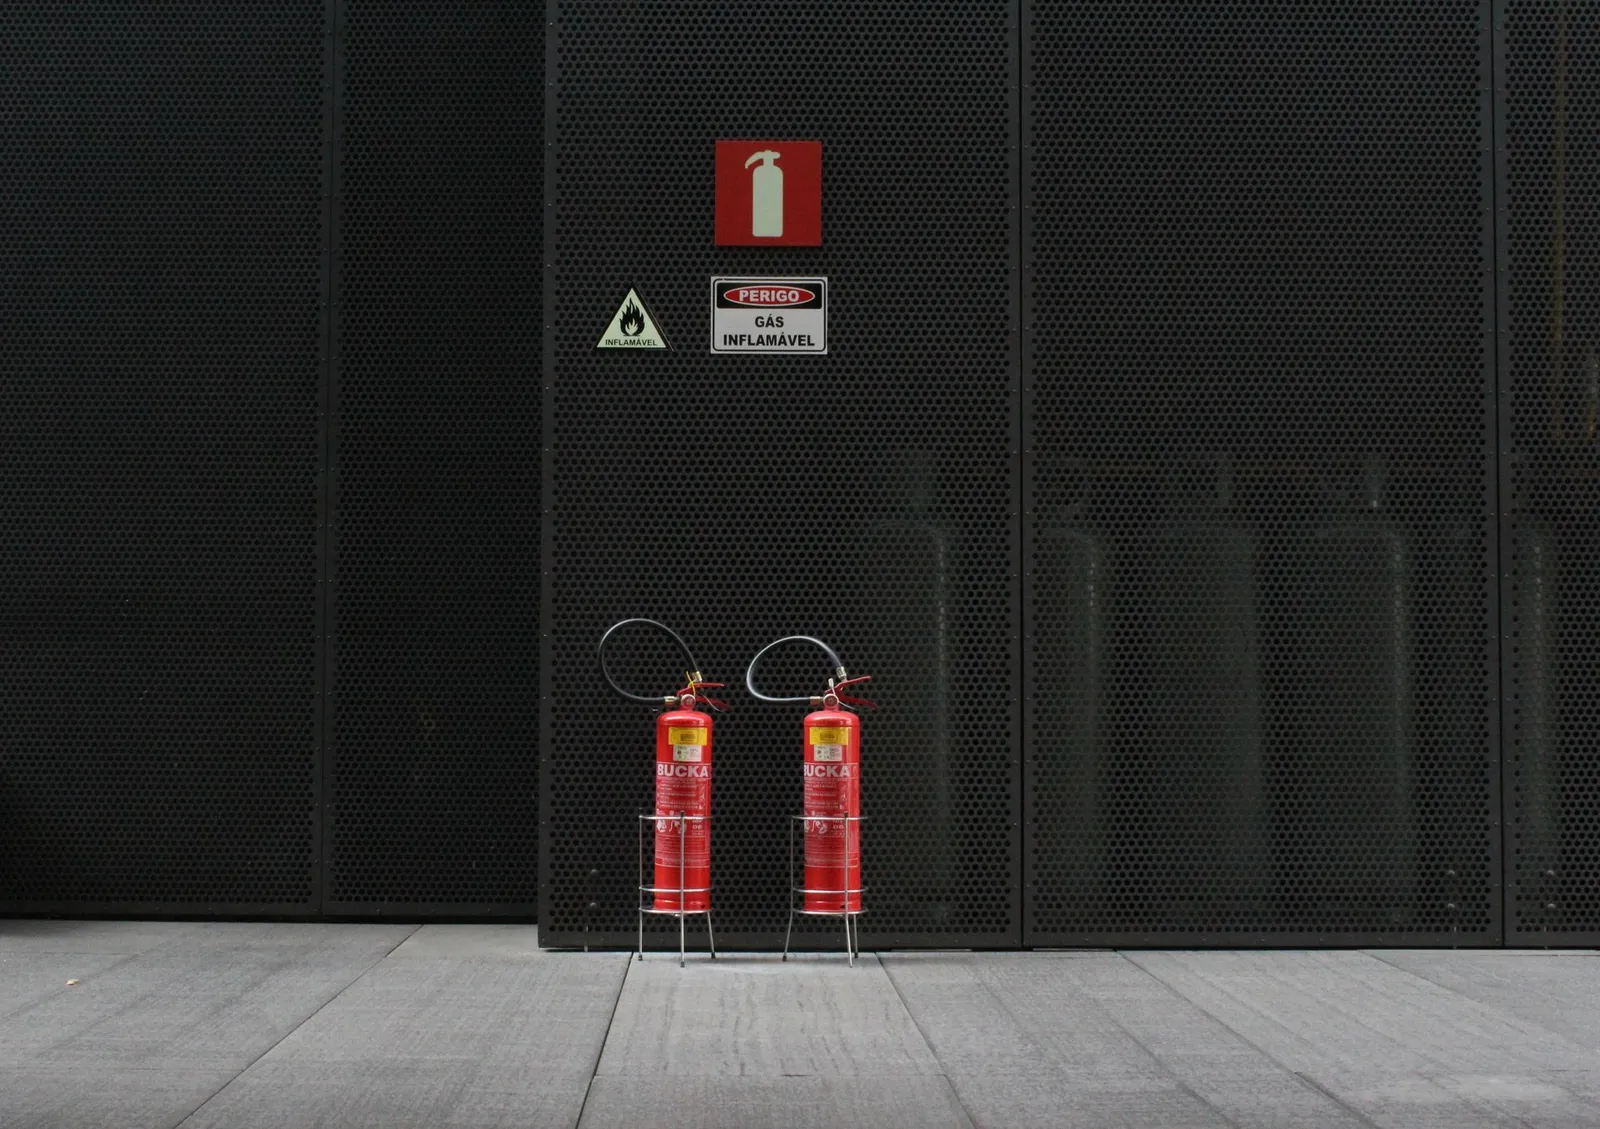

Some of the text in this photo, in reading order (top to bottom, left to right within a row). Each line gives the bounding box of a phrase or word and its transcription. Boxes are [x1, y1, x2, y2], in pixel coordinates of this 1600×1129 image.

[738, 290, 800, 302] PERIGO
[755, 314, 784, 328] GÁS
[605, 338, 657, 347] INFLAMÁVEL
[723, 332, 815, 346] INFLAMÁVEL
[657, 764, 708, 777] BUCKA
